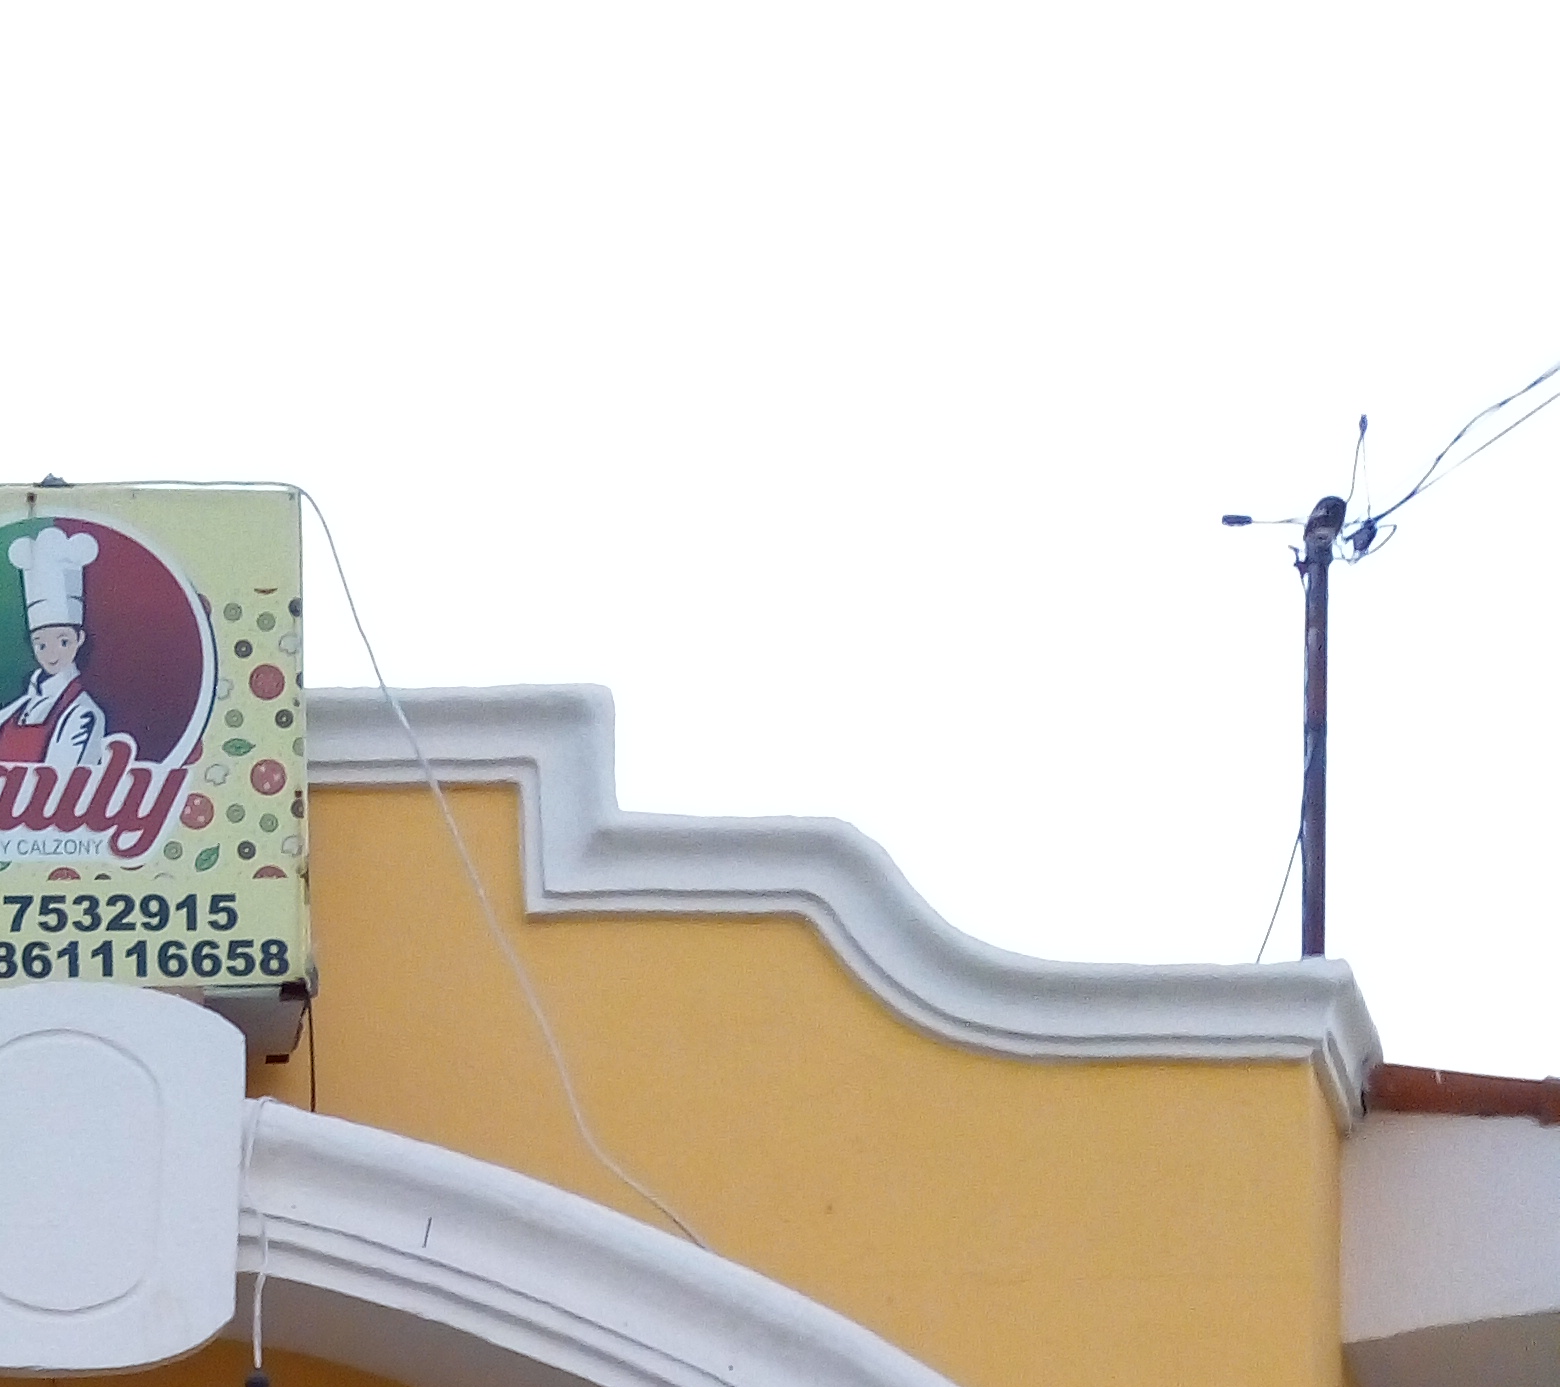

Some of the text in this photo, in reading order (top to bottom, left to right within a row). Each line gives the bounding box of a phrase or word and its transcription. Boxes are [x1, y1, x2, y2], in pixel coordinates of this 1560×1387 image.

[2, 839, 12, 856] Y
[16, 839, 104, 856] CALZONY
[3, 893, 239, 933] 7532915
